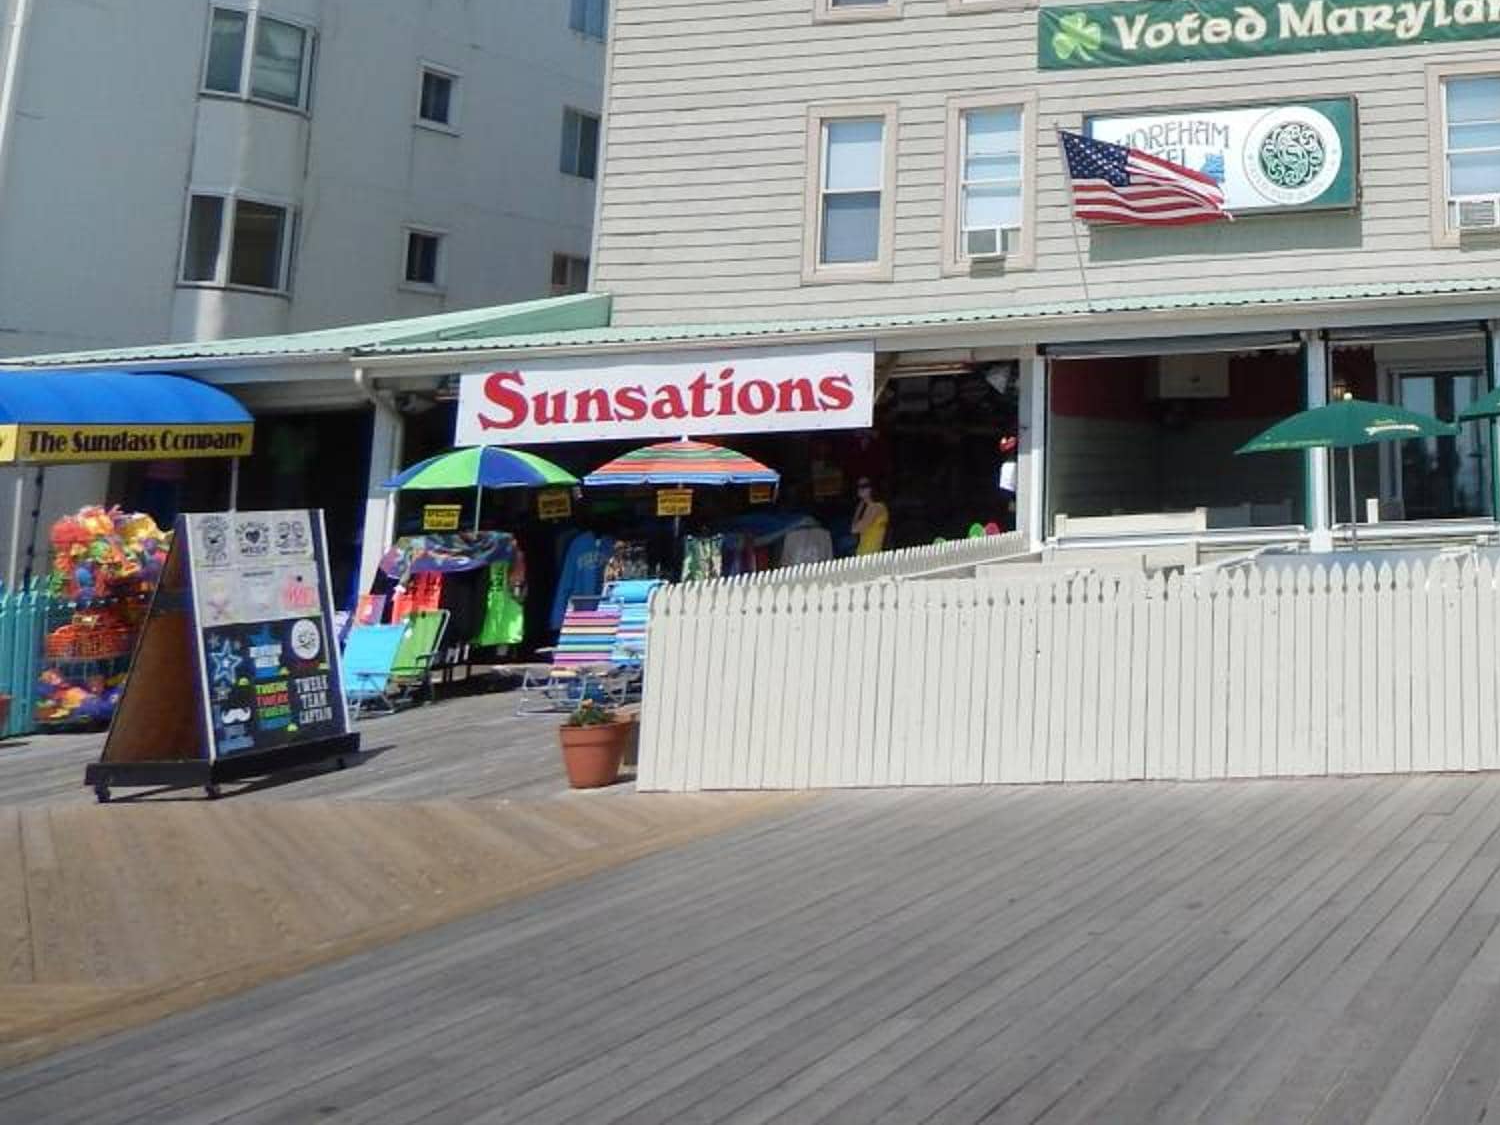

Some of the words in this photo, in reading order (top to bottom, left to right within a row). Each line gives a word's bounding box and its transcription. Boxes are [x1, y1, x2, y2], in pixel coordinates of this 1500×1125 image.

[1111, 6, 1268, 51] Voted
[476, 366, 855, 431] Sunsations
[28, 429, 68, 454] The
[71, 429, 158, 453] Sunglass
[160, 429, 244, 452] Company
